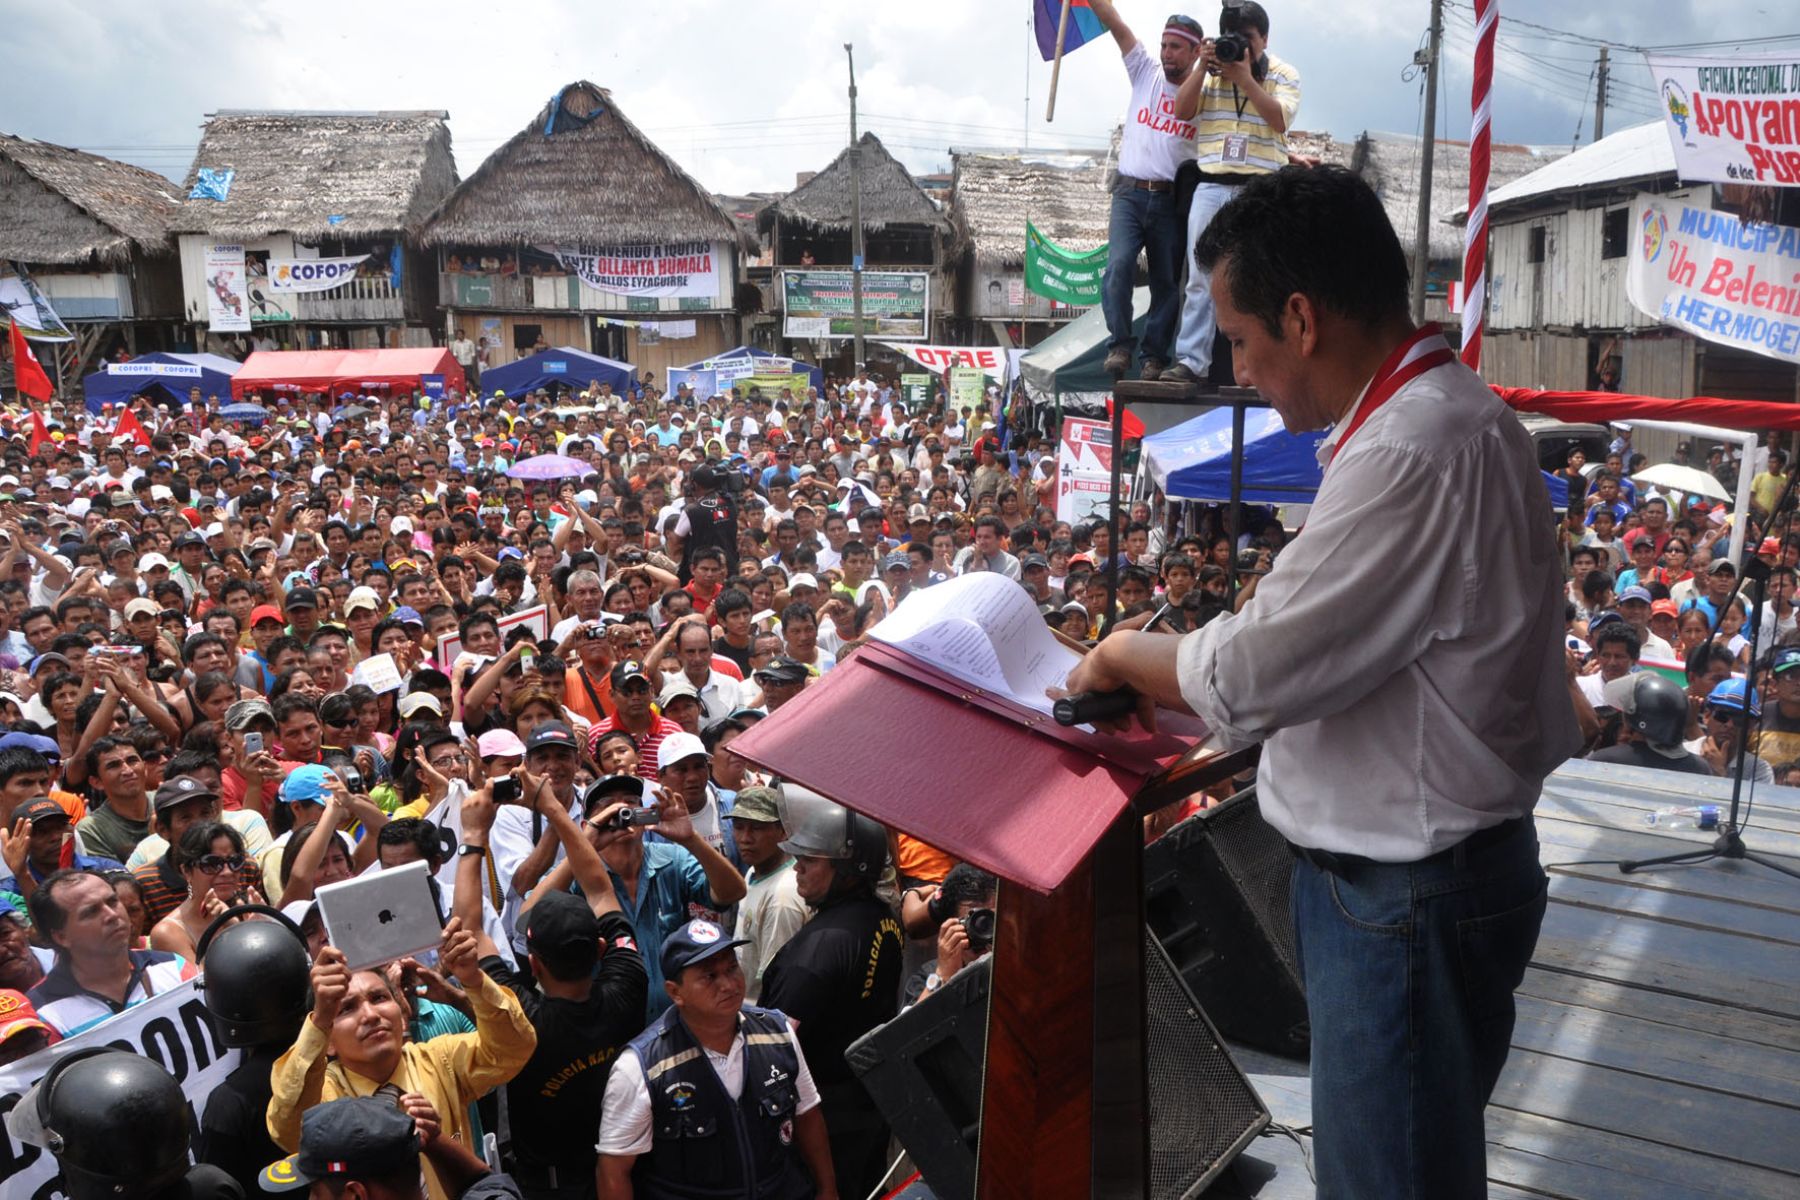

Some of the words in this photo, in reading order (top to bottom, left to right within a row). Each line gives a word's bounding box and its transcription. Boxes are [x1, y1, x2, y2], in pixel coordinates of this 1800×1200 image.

[1698, 66, 1735, 94] OFICINA
[1738, 65, 1787, 94] REGIONAL
[1137, 106, 1198, 141] OLLANTA
[579, 243, 651, 258] BIENVENIDO
[654, 245, 662, 258] A
[598, 256, 655, 276] OLLANTA
[658, 255, 712, 275] HUMALA
[1667, 239, 1697, 288] Un
[631, 275, 689, 288] EYZAGUIRRE
[164, 366, 198, 374] COFOPRI
